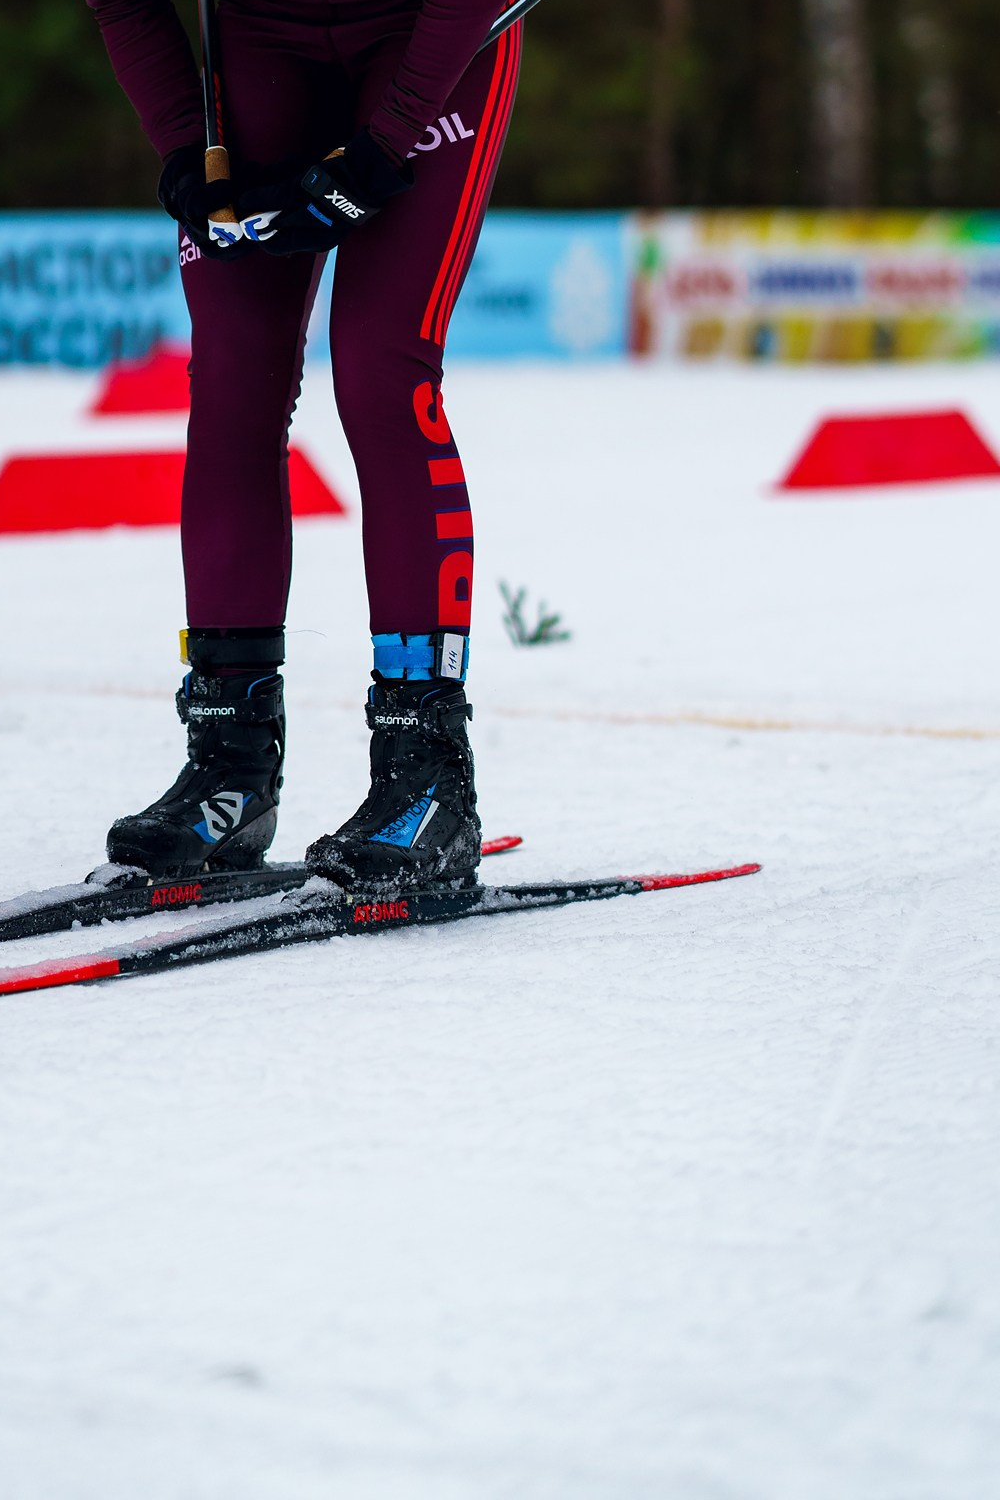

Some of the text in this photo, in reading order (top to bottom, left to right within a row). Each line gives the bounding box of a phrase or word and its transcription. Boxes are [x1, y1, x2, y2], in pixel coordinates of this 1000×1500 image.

[324, 189, 366, 219] SWIX
[151, 883, 204, 907] ATOMIC
[353, 900, 409, 925] ATOMIC
